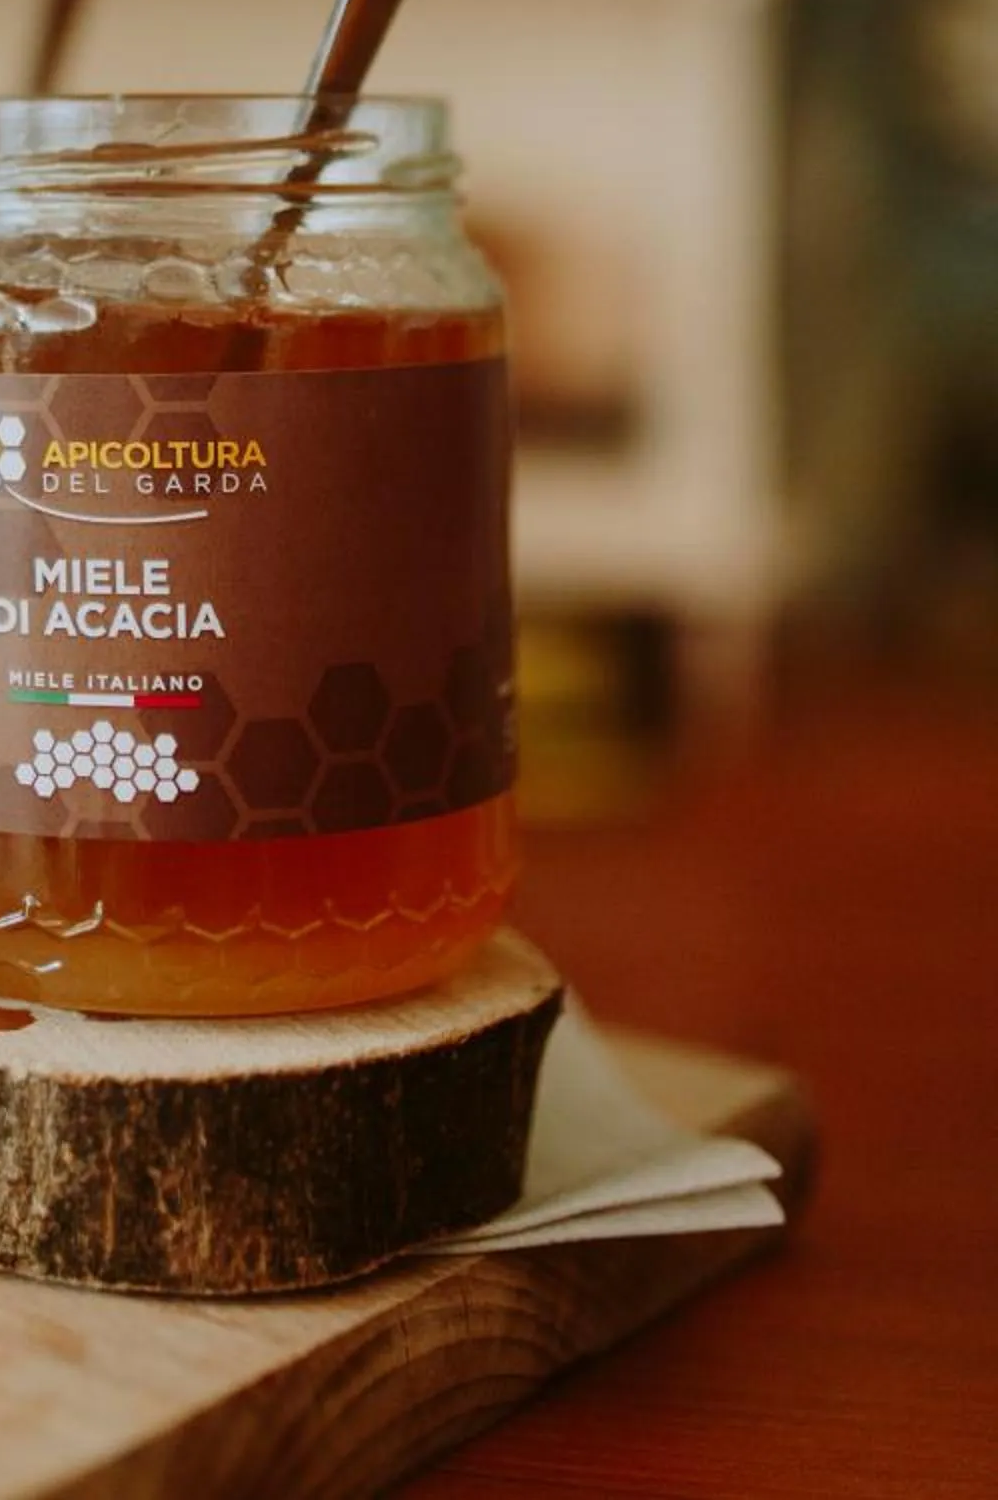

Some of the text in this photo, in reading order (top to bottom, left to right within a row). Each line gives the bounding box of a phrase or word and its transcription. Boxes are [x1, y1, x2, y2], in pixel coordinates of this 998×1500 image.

[42, 440, 267, 469] APICOLTURA
[42, 472, 267, 493] DEL GARDA
[34, 558, 170, 594] MIELE
[44, 602, 225, 638] ACACIA
[9, 671, 203, 691] MIELE ITALIANO
